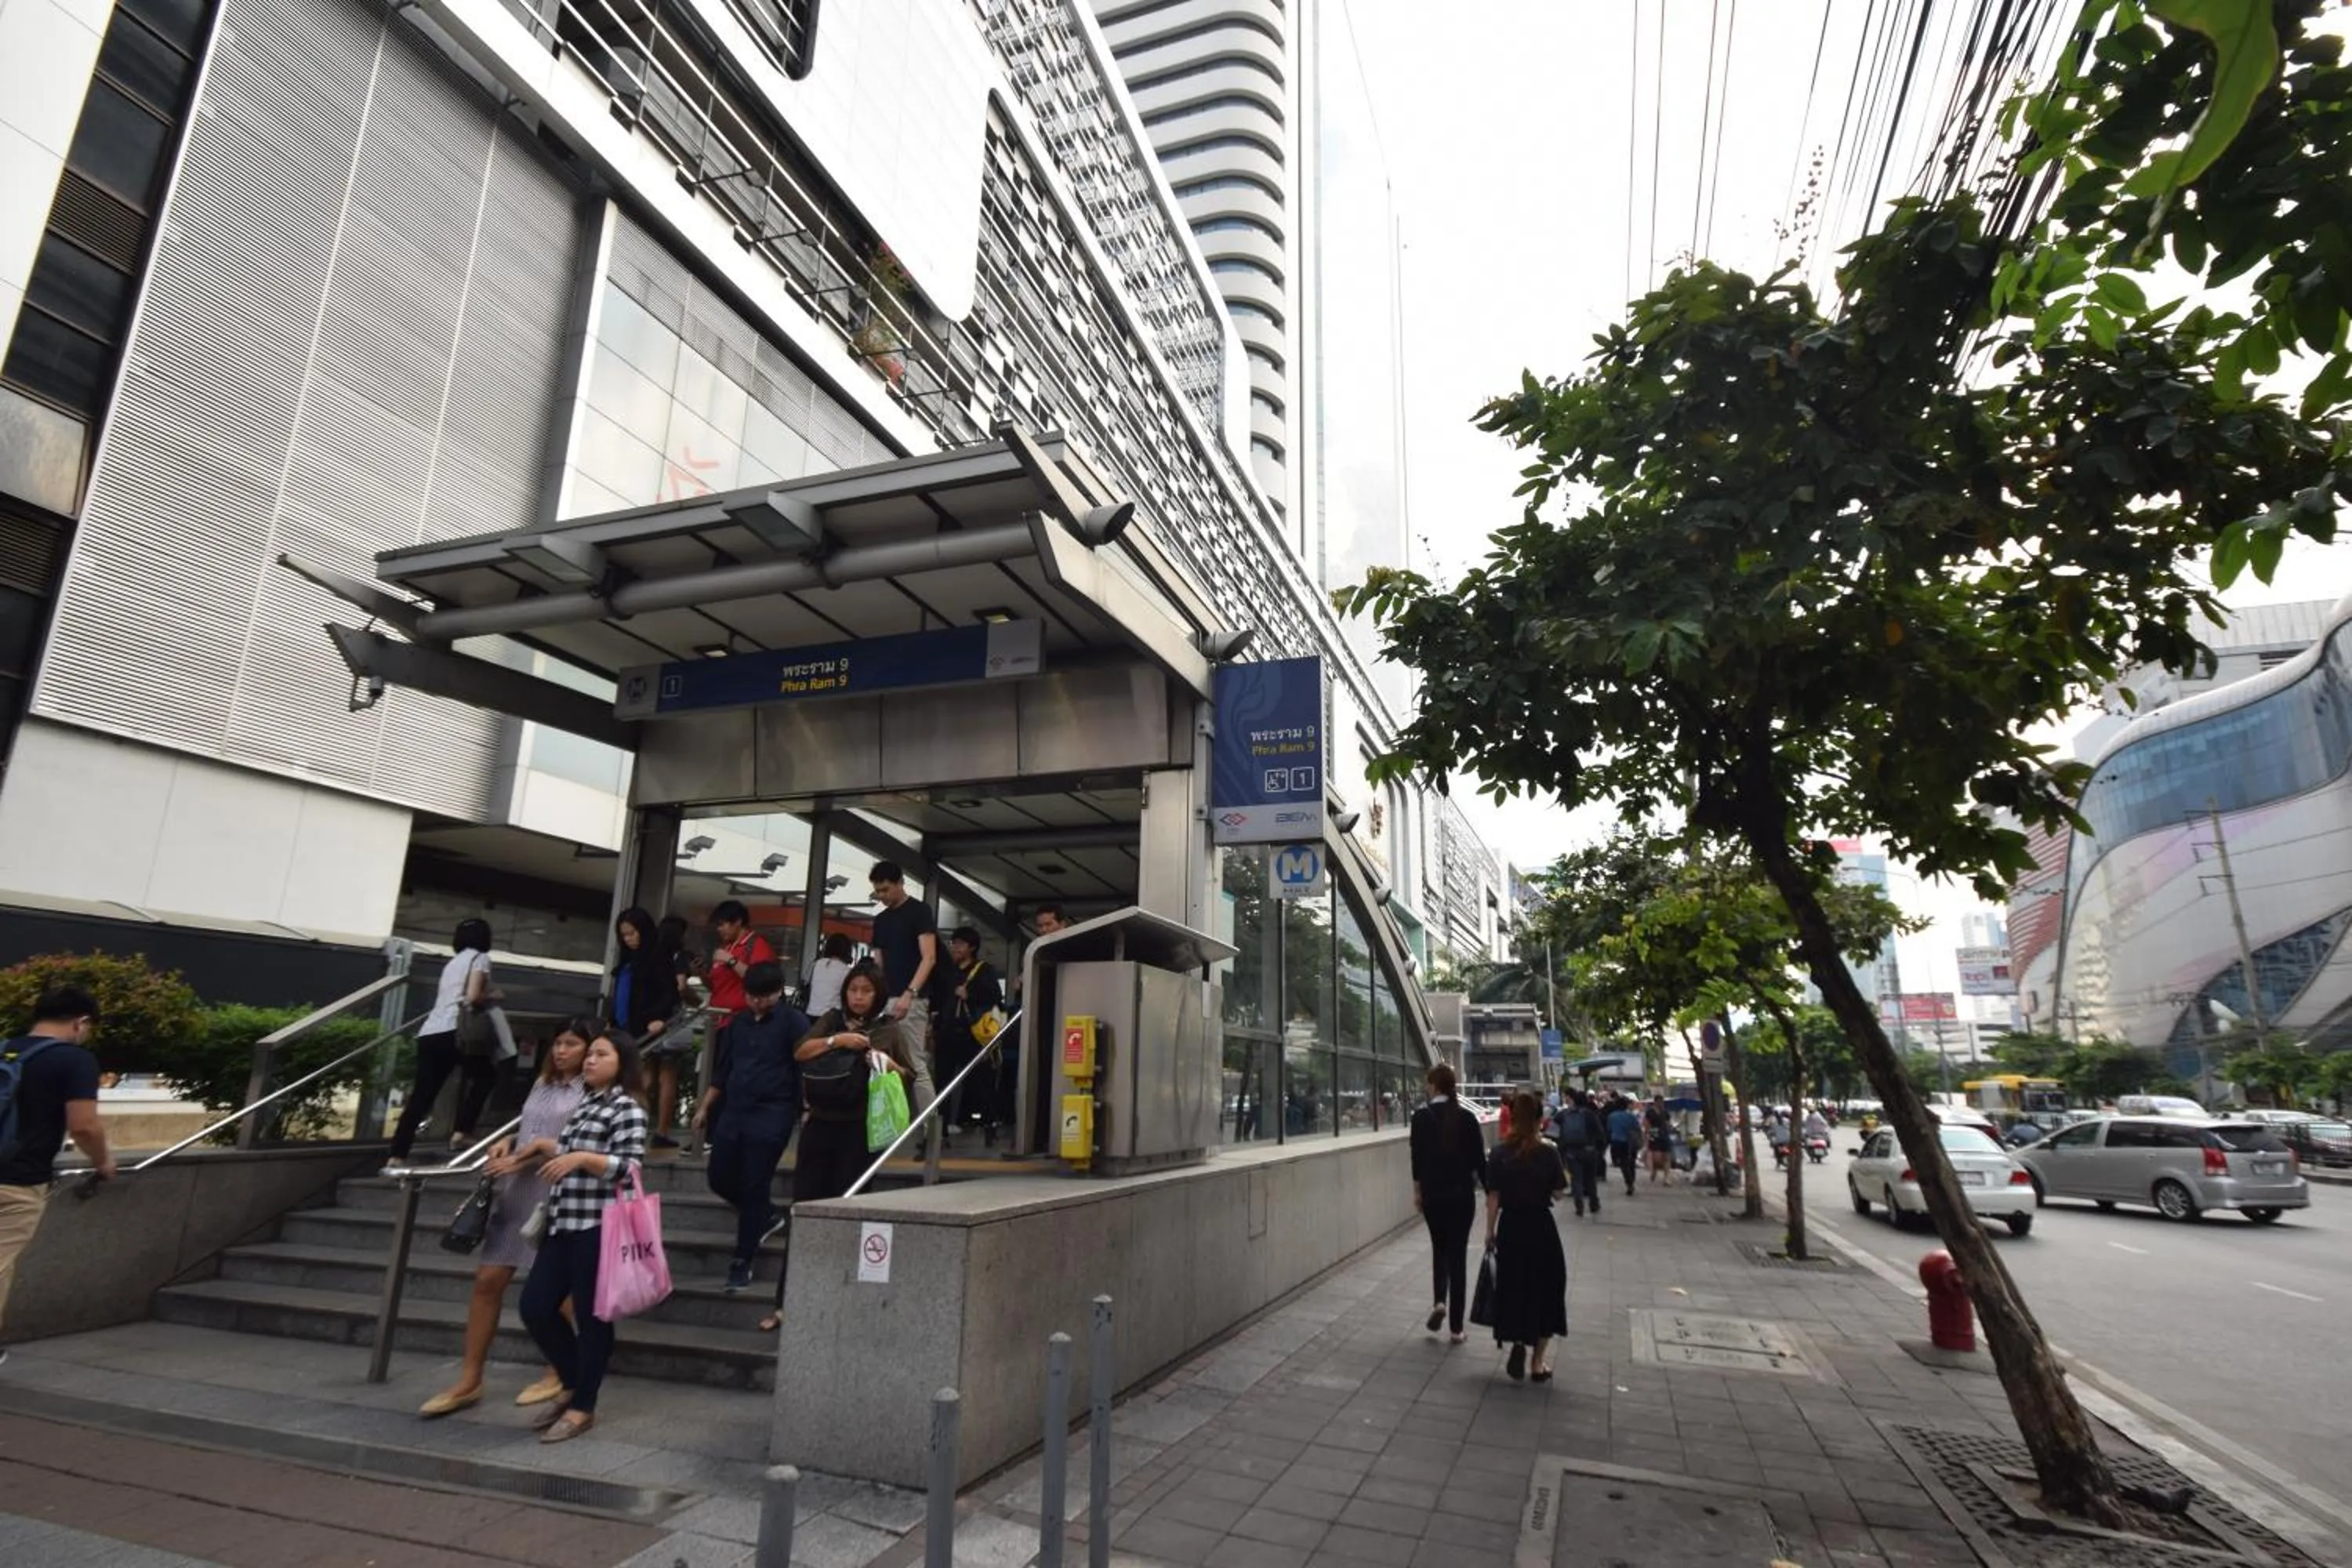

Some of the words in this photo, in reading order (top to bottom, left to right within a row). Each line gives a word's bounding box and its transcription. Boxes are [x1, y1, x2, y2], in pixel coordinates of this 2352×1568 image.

[782, 661, 835, 677] พระราม
[840, 658, 849, 671] 9
[781, 681, 807, 693] Phra
[810, 677, 836, 691] Ram
[839, 674, 848, 687] 9
[1250, 728, 1302, 742] พระราม
[1251, 746, 1277, 757] Phra
[1279, 742, 1305, 753] Ram
[1282, 851, 1313, 880] M
